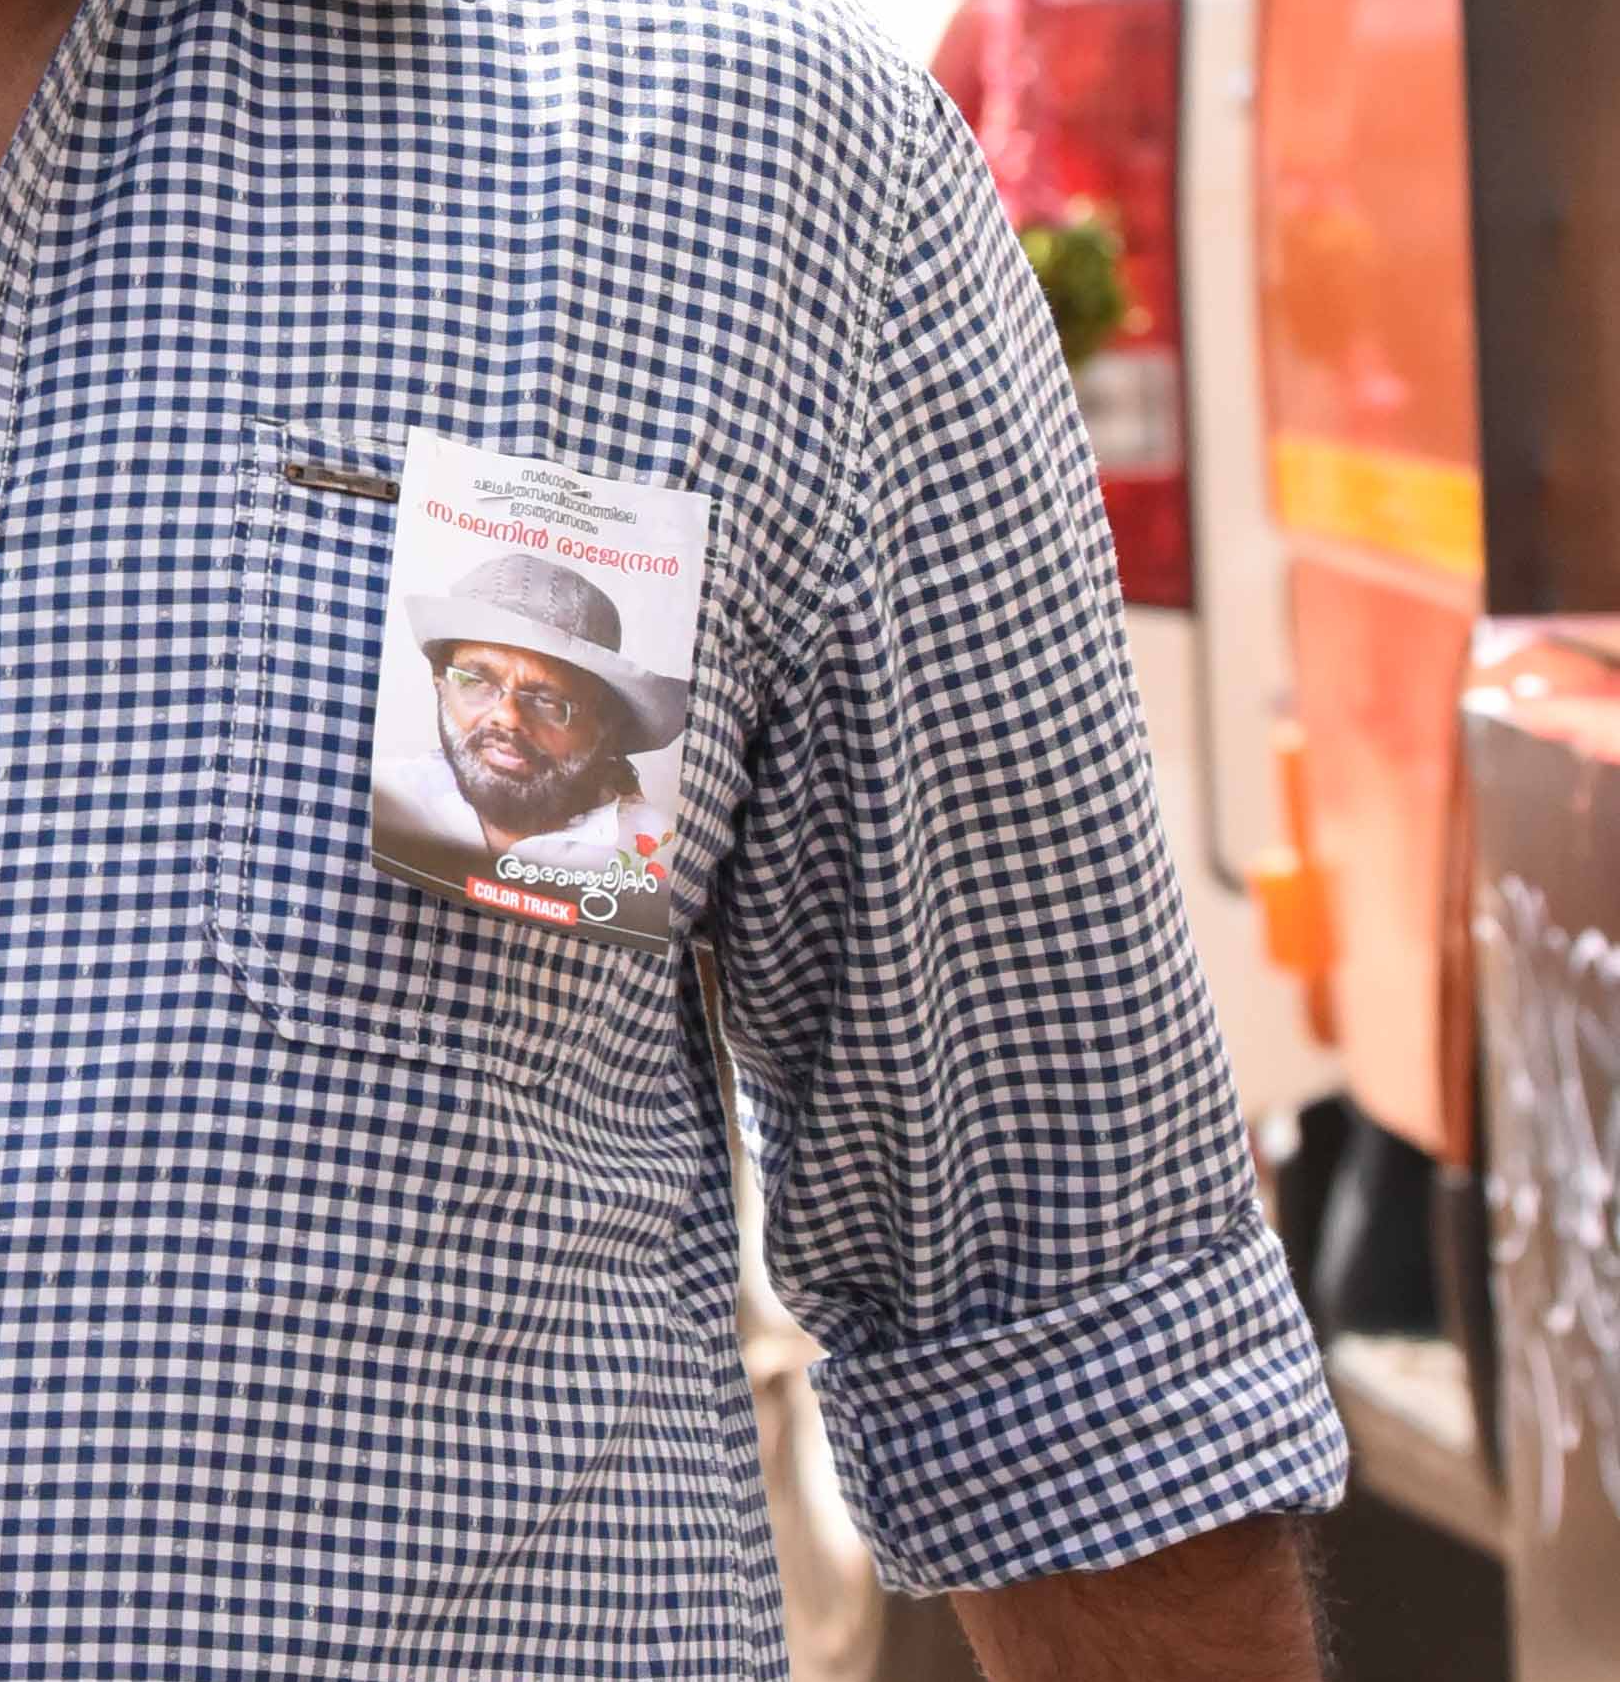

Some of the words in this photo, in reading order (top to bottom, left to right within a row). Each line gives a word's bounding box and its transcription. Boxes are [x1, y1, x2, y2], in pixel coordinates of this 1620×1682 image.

[556, 536, 680, 577] രാജേന്ദ്രൻ
[474, 881, 520, 910] COLOR
[523, 894, 570, 921] TRACK
